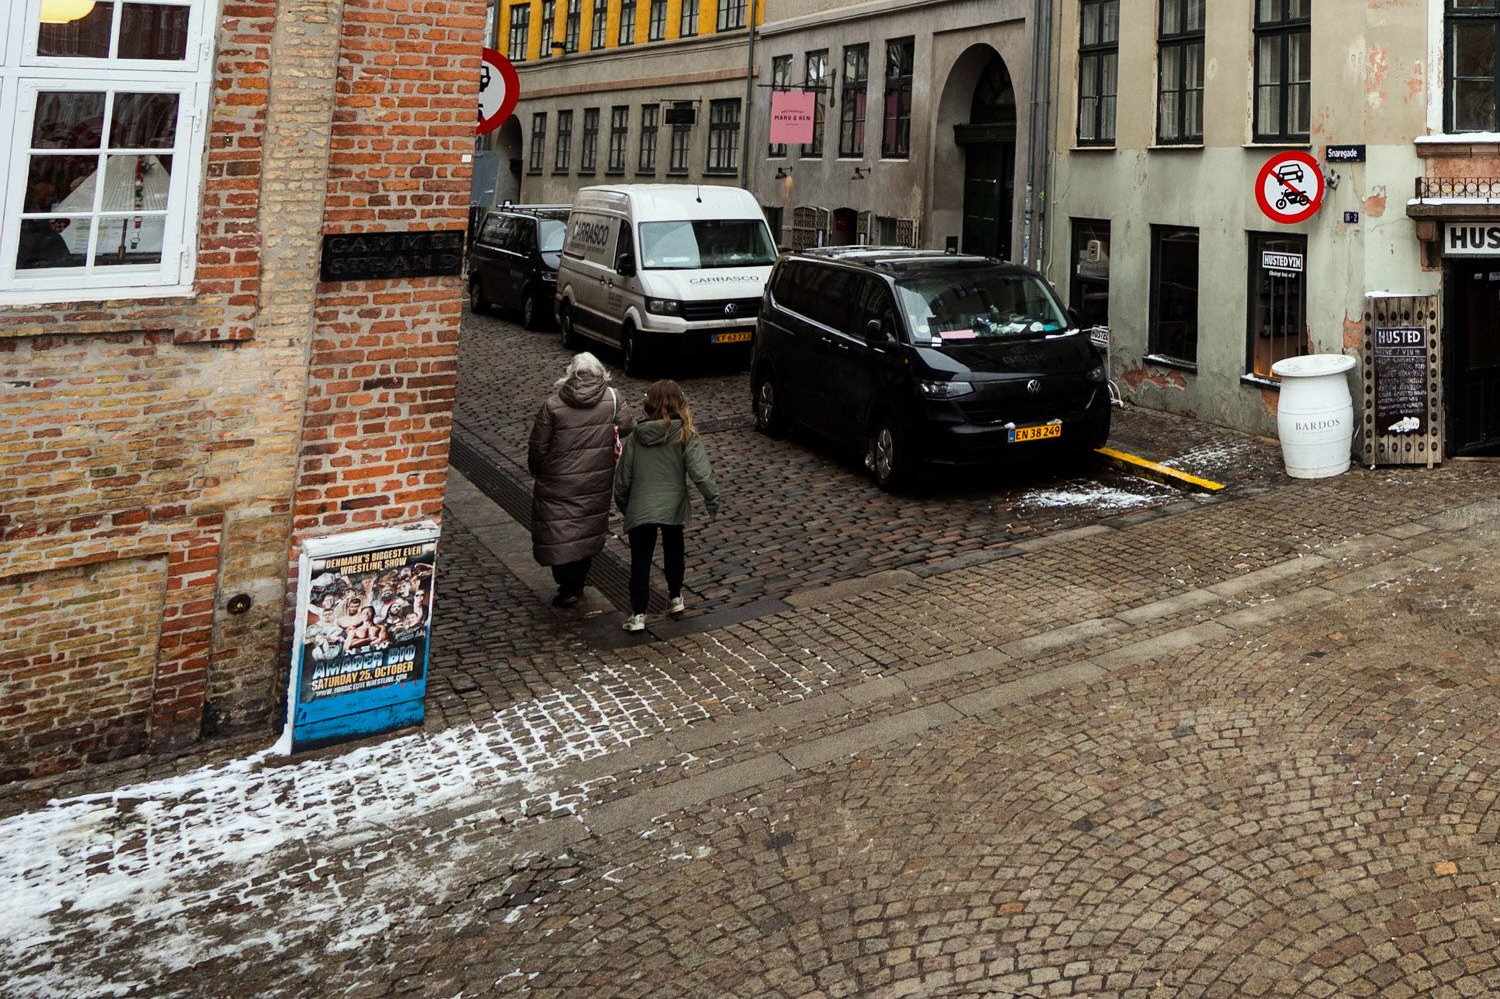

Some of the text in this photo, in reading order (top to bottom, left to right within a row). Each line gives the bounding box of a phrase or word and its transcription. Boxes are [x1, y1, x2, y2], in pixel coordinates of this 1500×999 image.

[1328, 148, 1357, 159] Snaregade
[573, 221, 609, 246] CARRASCO
[330, 254, 457, 274] STRAND
[1264, 254, 1301, 268] HUSTED VIN
[689, 275, 759, 284] CARRASCO
[1378, 330, 1421, 344] HUSTED
[1295, 419, 1341, 431] BARDOS
[1015, 426, 1060, 440] EN 38 249
[326, 545, 422, 569] DENMARK'S BIGGEST EVER
[384, 557, 408, 569] SHOW
[312, 645, 416, 680] AMAGER BIO
[311, 661, 414, 691] SATURDAY 25. OCTOBER
